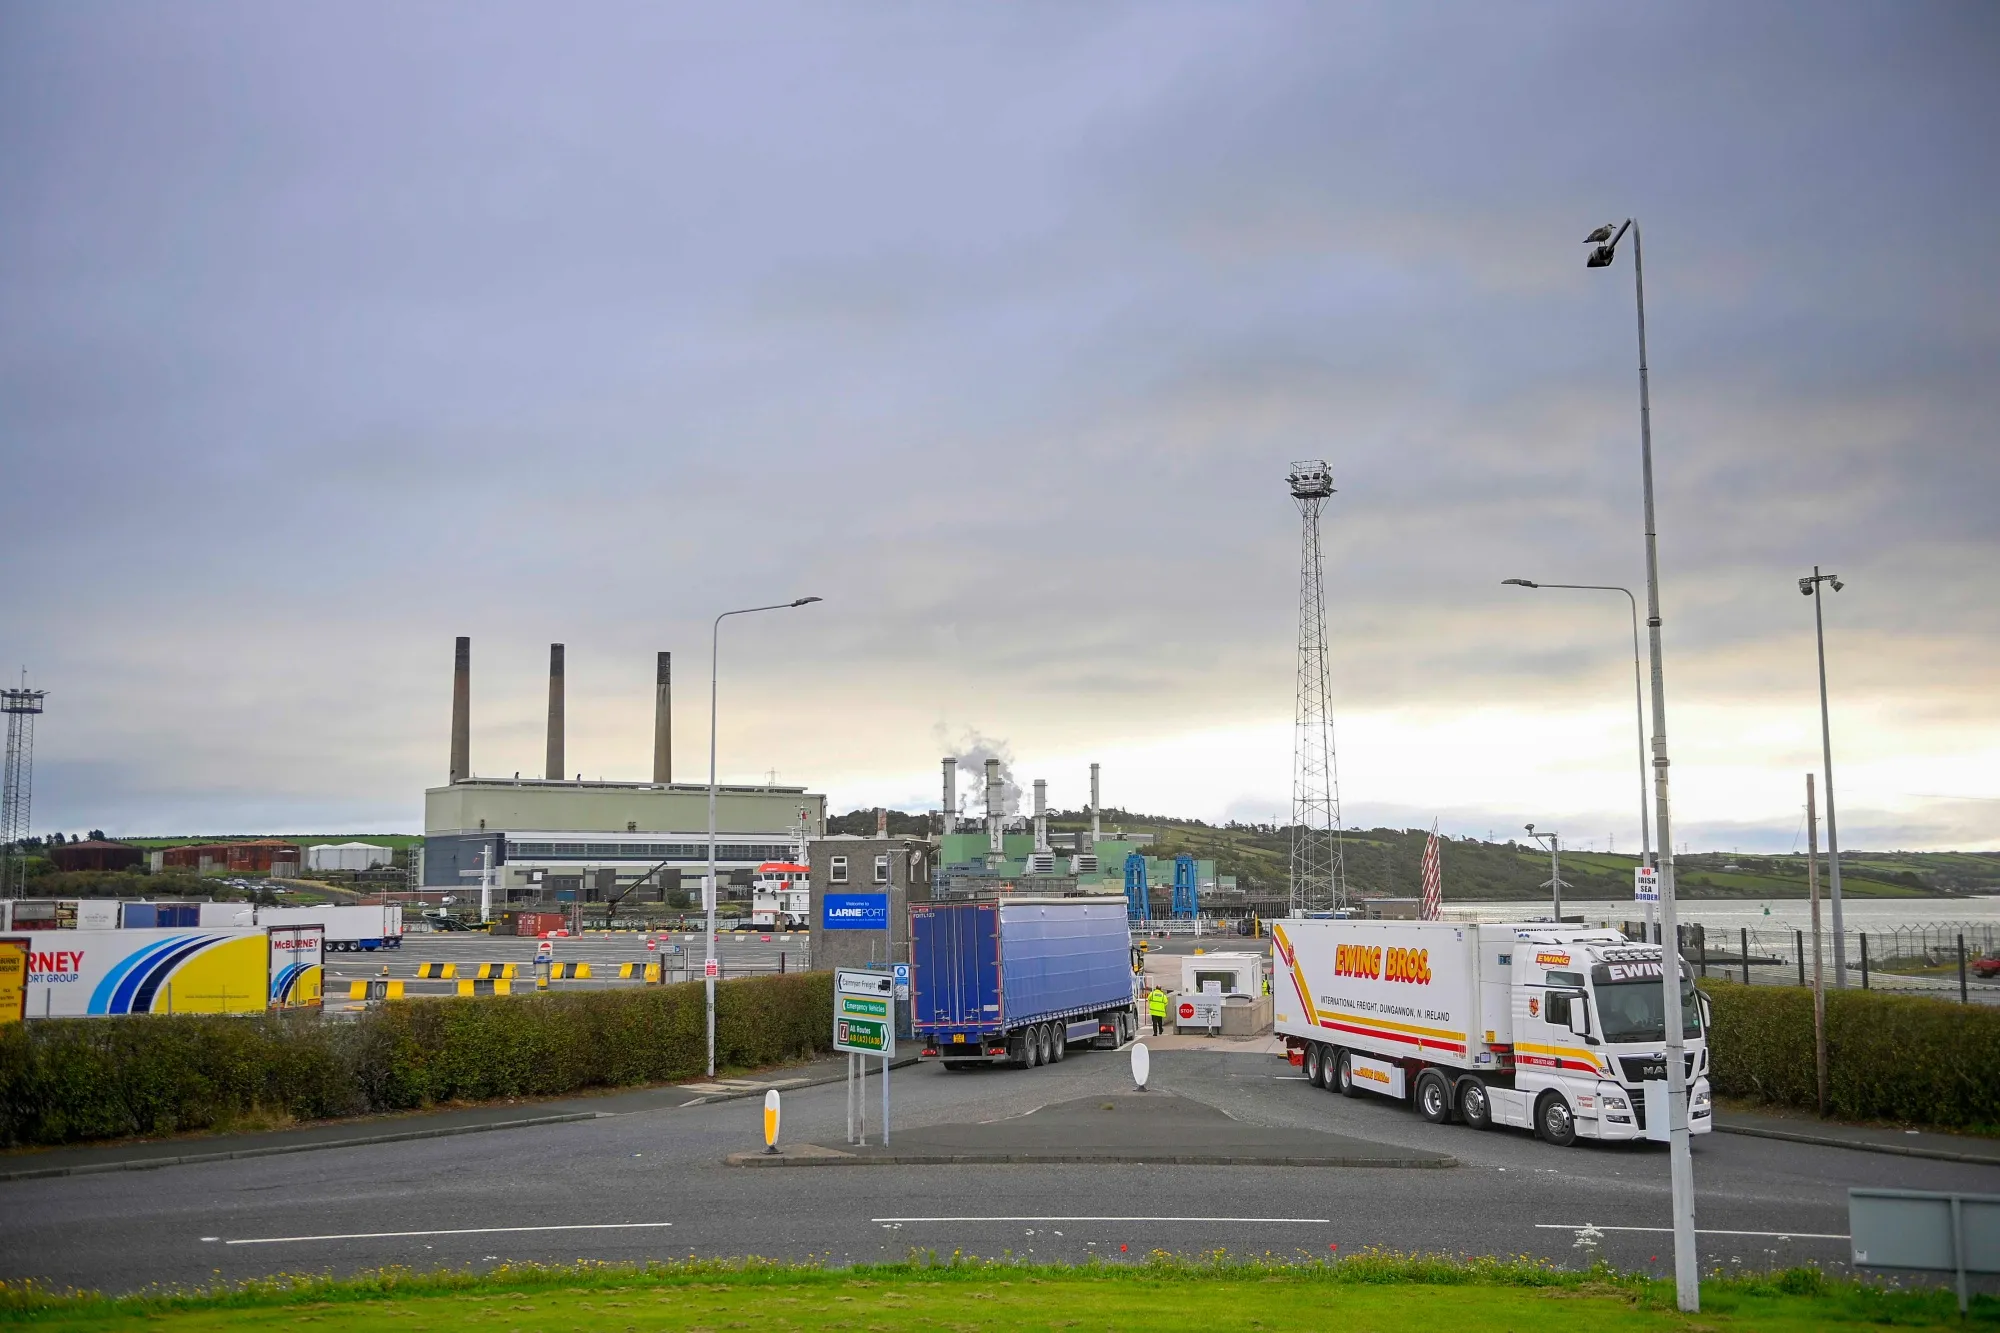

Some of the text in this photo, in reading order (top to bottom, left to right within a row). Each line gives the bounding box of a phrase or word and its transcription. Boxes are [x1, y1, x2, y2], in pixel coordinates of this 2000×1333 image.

[829, 908, 885, 917] LARNEPORT
[274, 938, 318, 949] McBURNEY
[1335, 943, 1431, 985] EWING BROS.
[1537, 955, 1569, 964] EWING
[46, 973, 79, 983] GROUP
[862, 980, 876, 989] Freight
[846, 1001, 885, 1013] Emergency Vehicles
[1321, 995, 1450, 1022] INTERNATIONAL FREIGHT, DUNGANNON, N. IRELAND
[856, 1025, 871, 1034] Routes
[1643, 1065, 1667, 1075] MA
